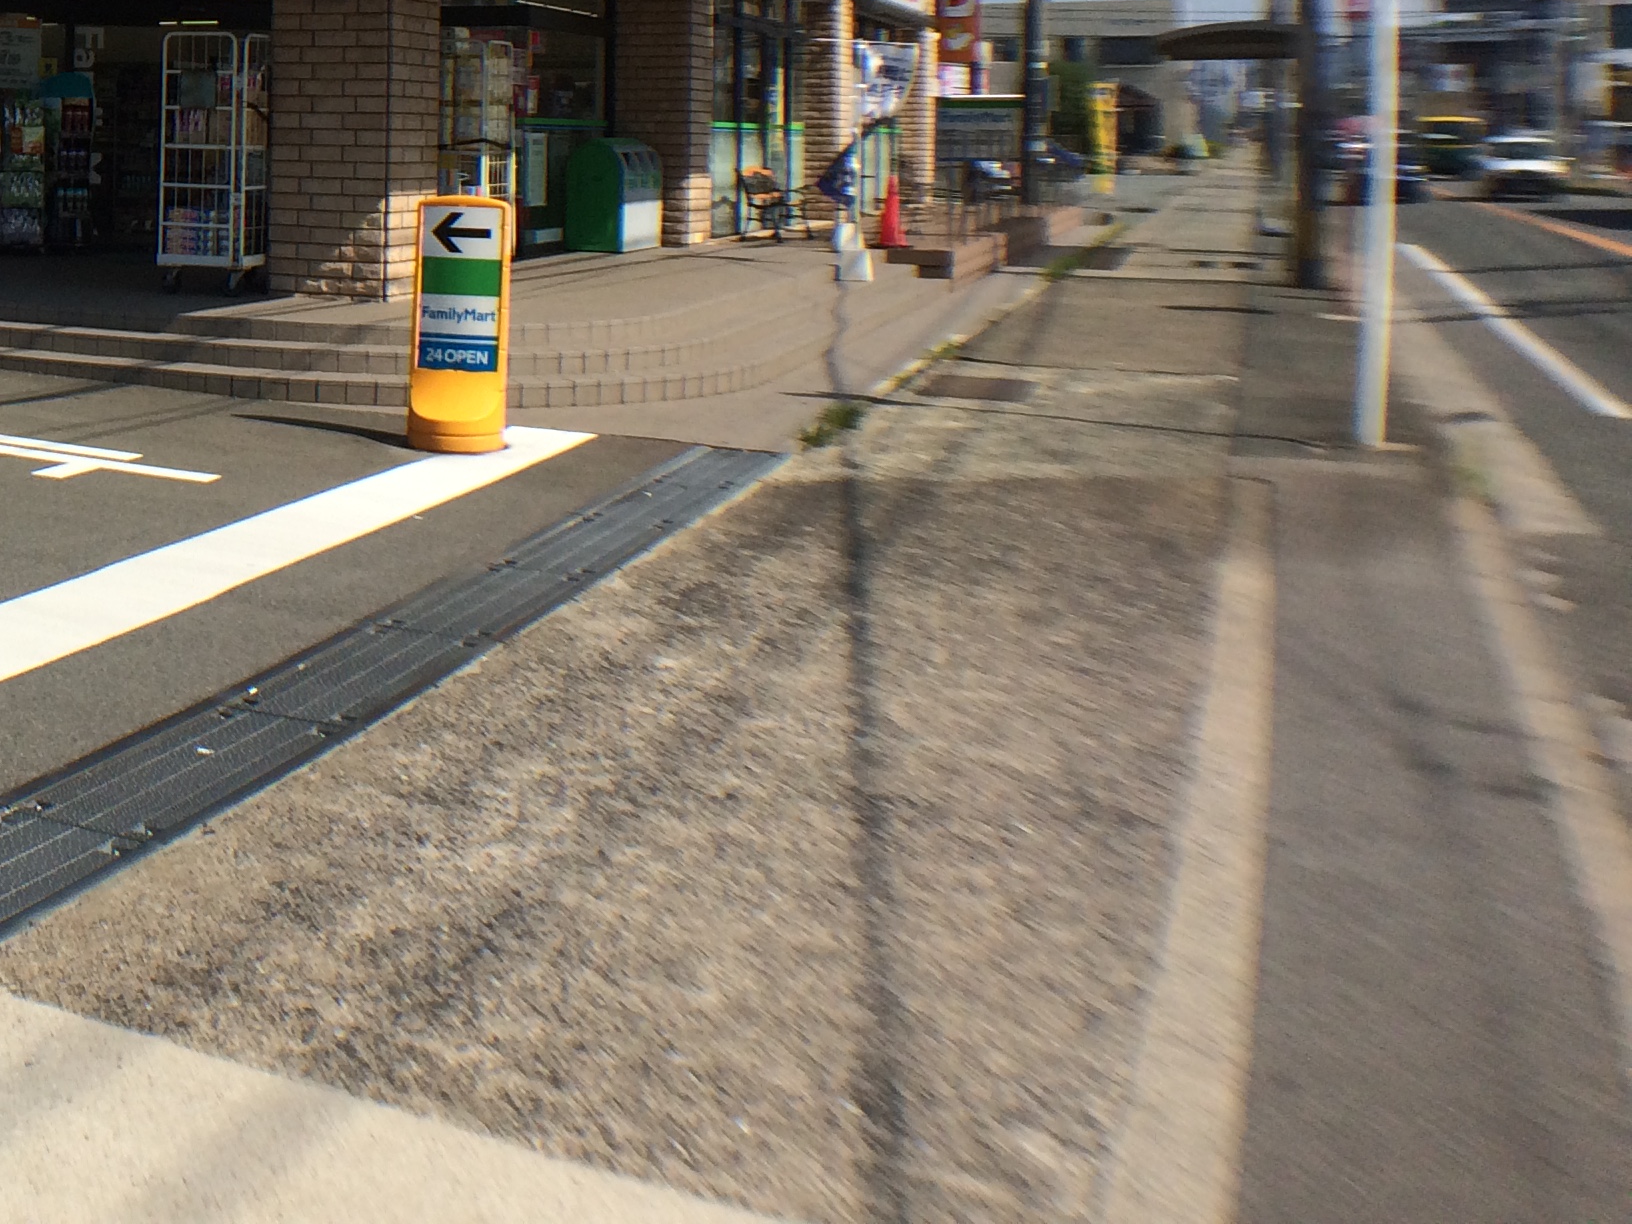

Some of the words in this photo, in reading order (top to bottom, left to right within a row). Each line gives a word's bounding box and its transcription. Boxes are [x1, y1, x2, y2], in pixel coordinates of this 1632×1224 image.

[421, 305, 496, 324] FamilyMart
[426, 347, 443, 363] 24
[444, 348, 489, 366] OPEN
